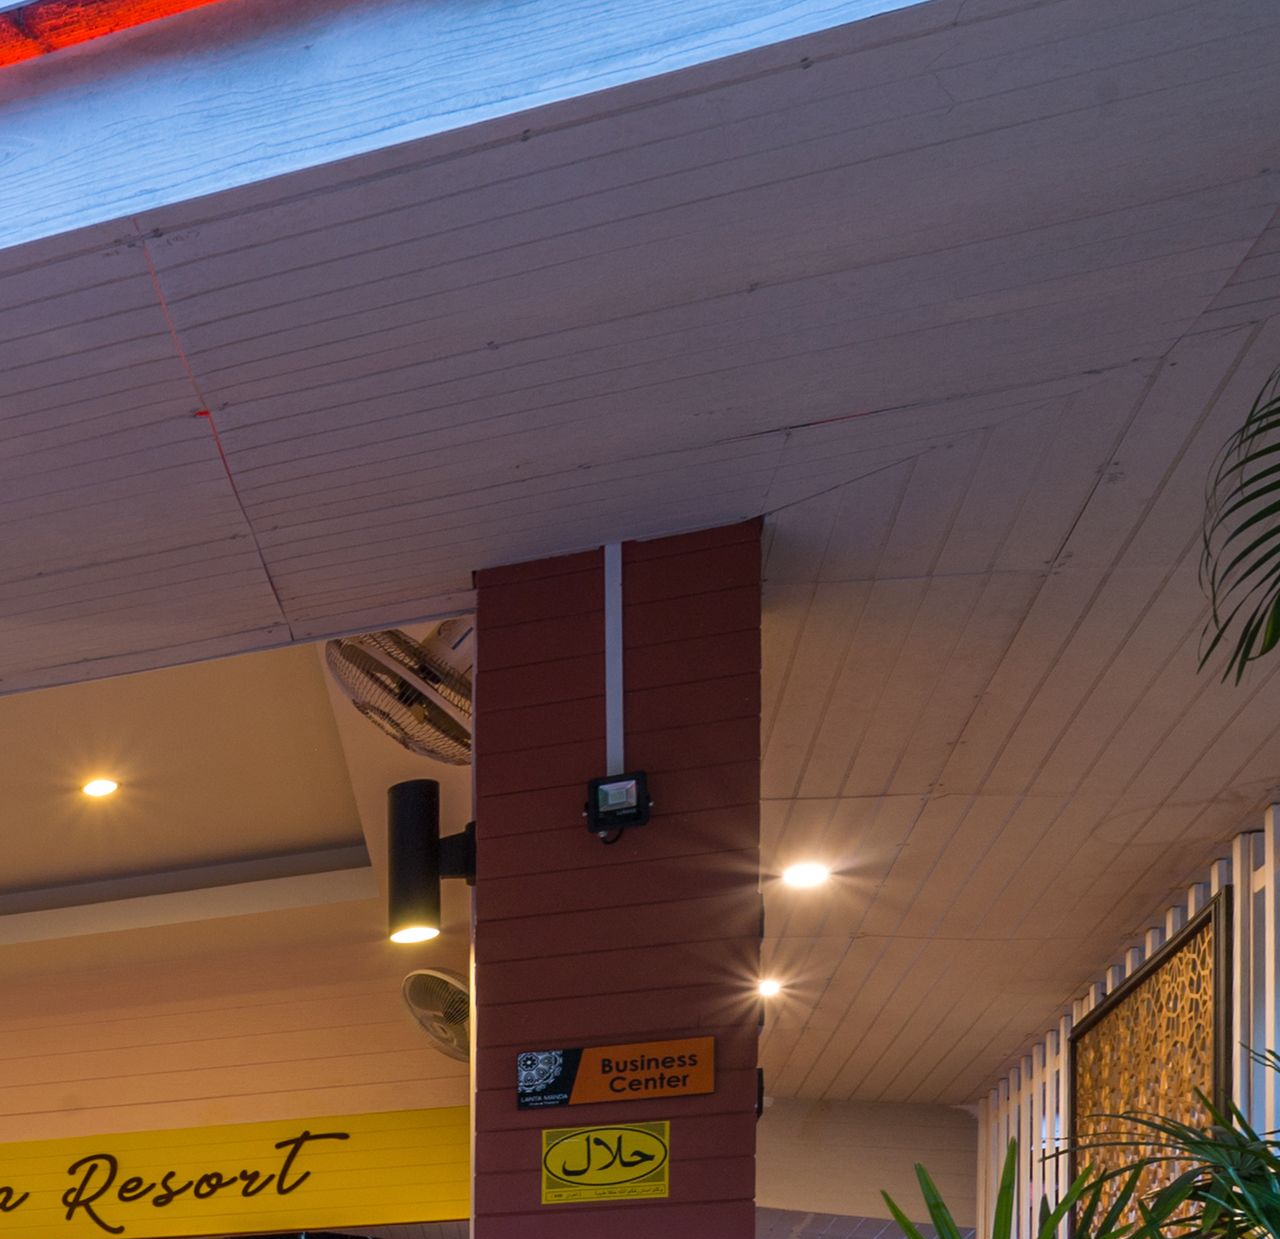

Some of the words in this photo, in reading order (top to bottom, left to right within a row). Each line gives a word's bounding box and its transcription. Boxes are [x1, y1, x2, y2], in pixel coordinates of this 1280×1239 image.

[601, 1054, 698, 1074] Business
[609, 1074, 689, 1093] Center
[562, 1135, 655, 1176] حلال
[61, 1130, 349, 1234] Resort
